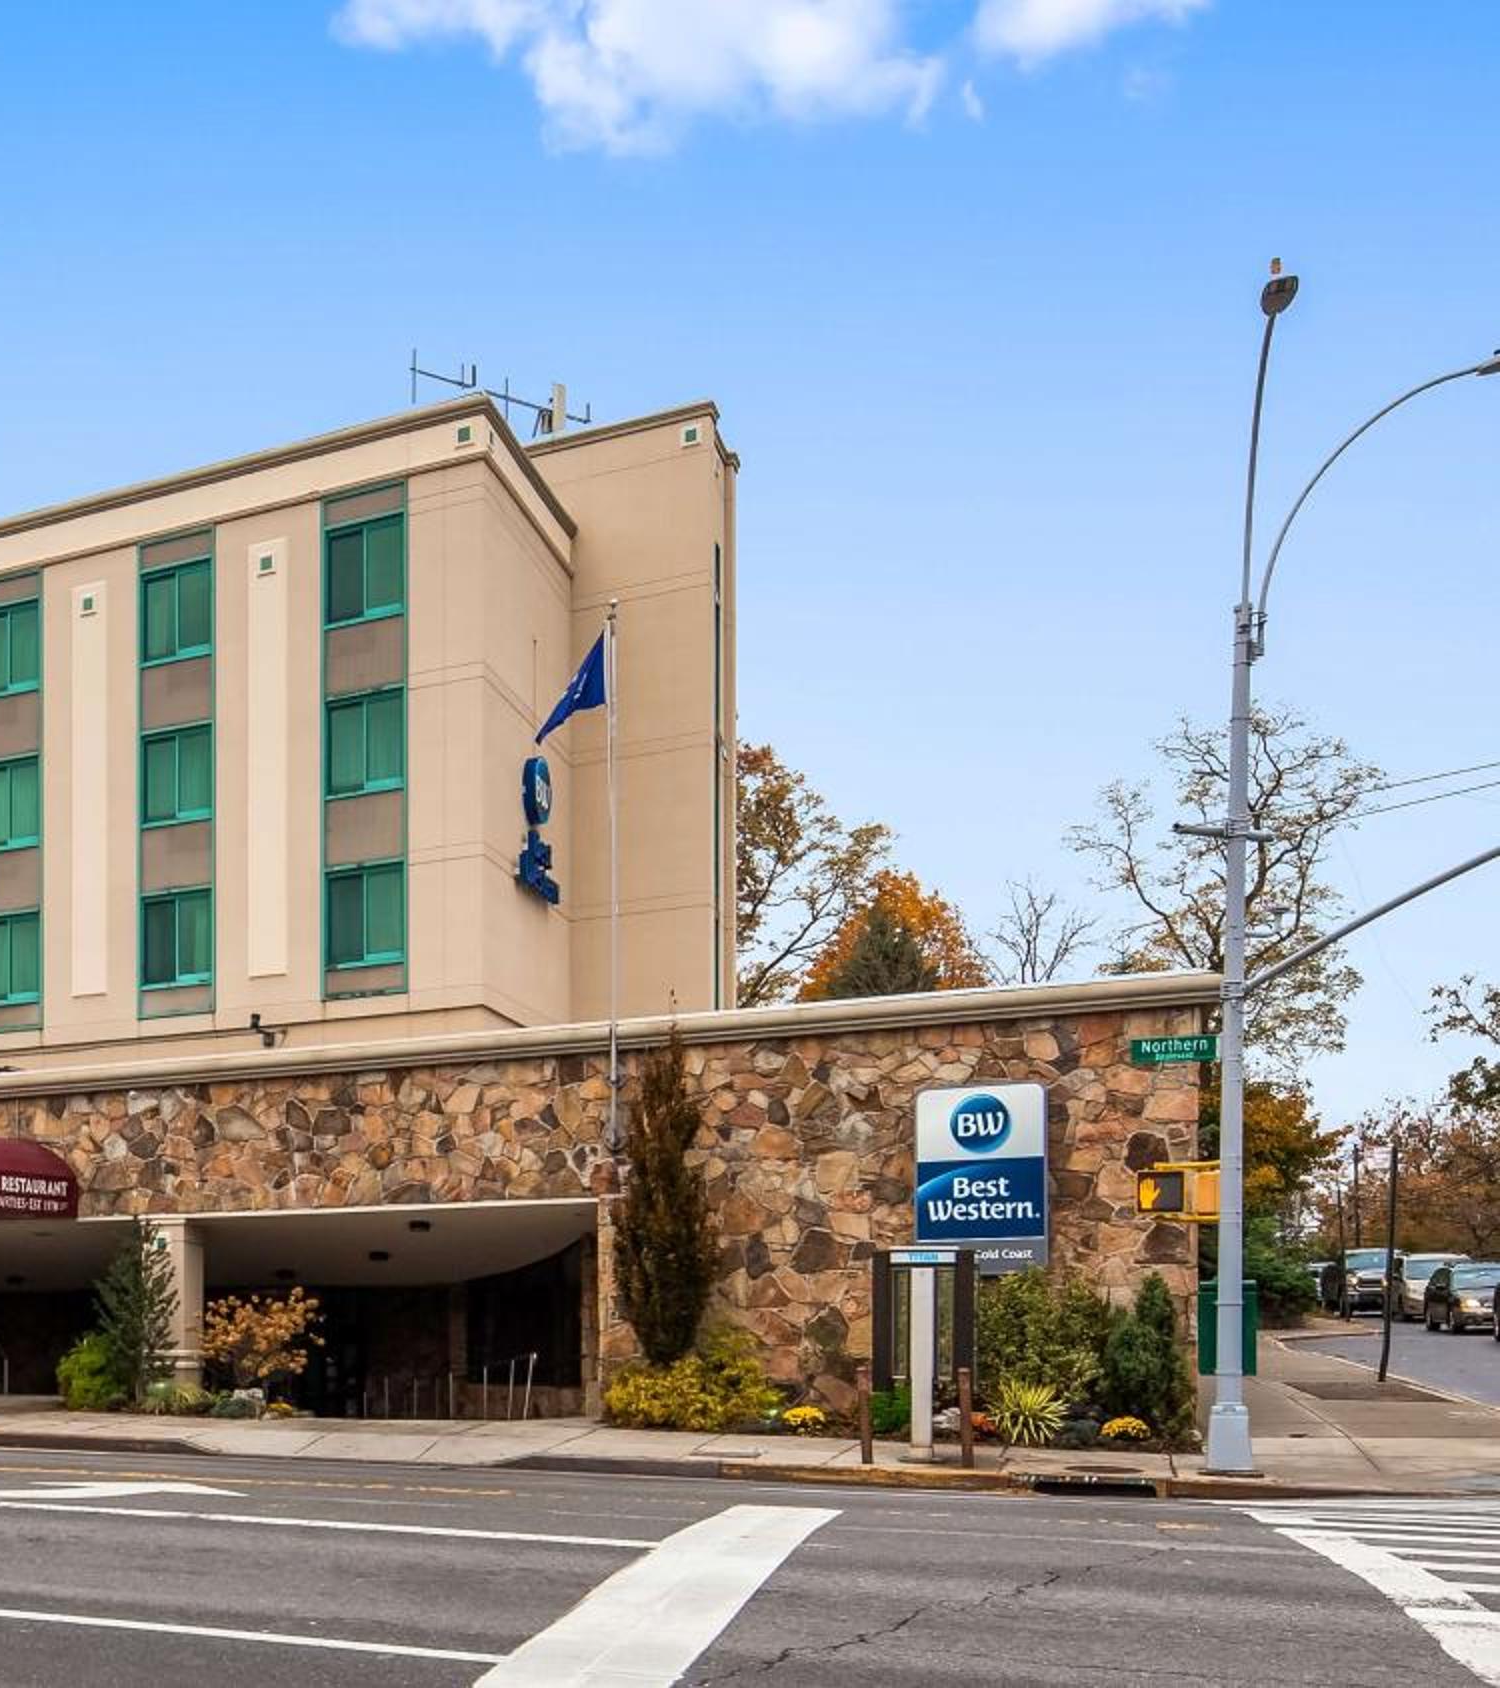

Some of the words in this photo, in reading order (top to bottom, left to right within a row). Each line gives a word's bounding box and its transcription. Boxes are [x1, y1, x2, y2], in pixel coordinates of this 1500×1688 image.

[1141, 1039, 1209, 1054] Northern
[957, 1112, 1004, 1137] BW
[1, 1175, 68, 1197] RESTAURANT
[953, 1177, 1010, 1198] Best
[1001, 1249, 1033, 1259] Coast
